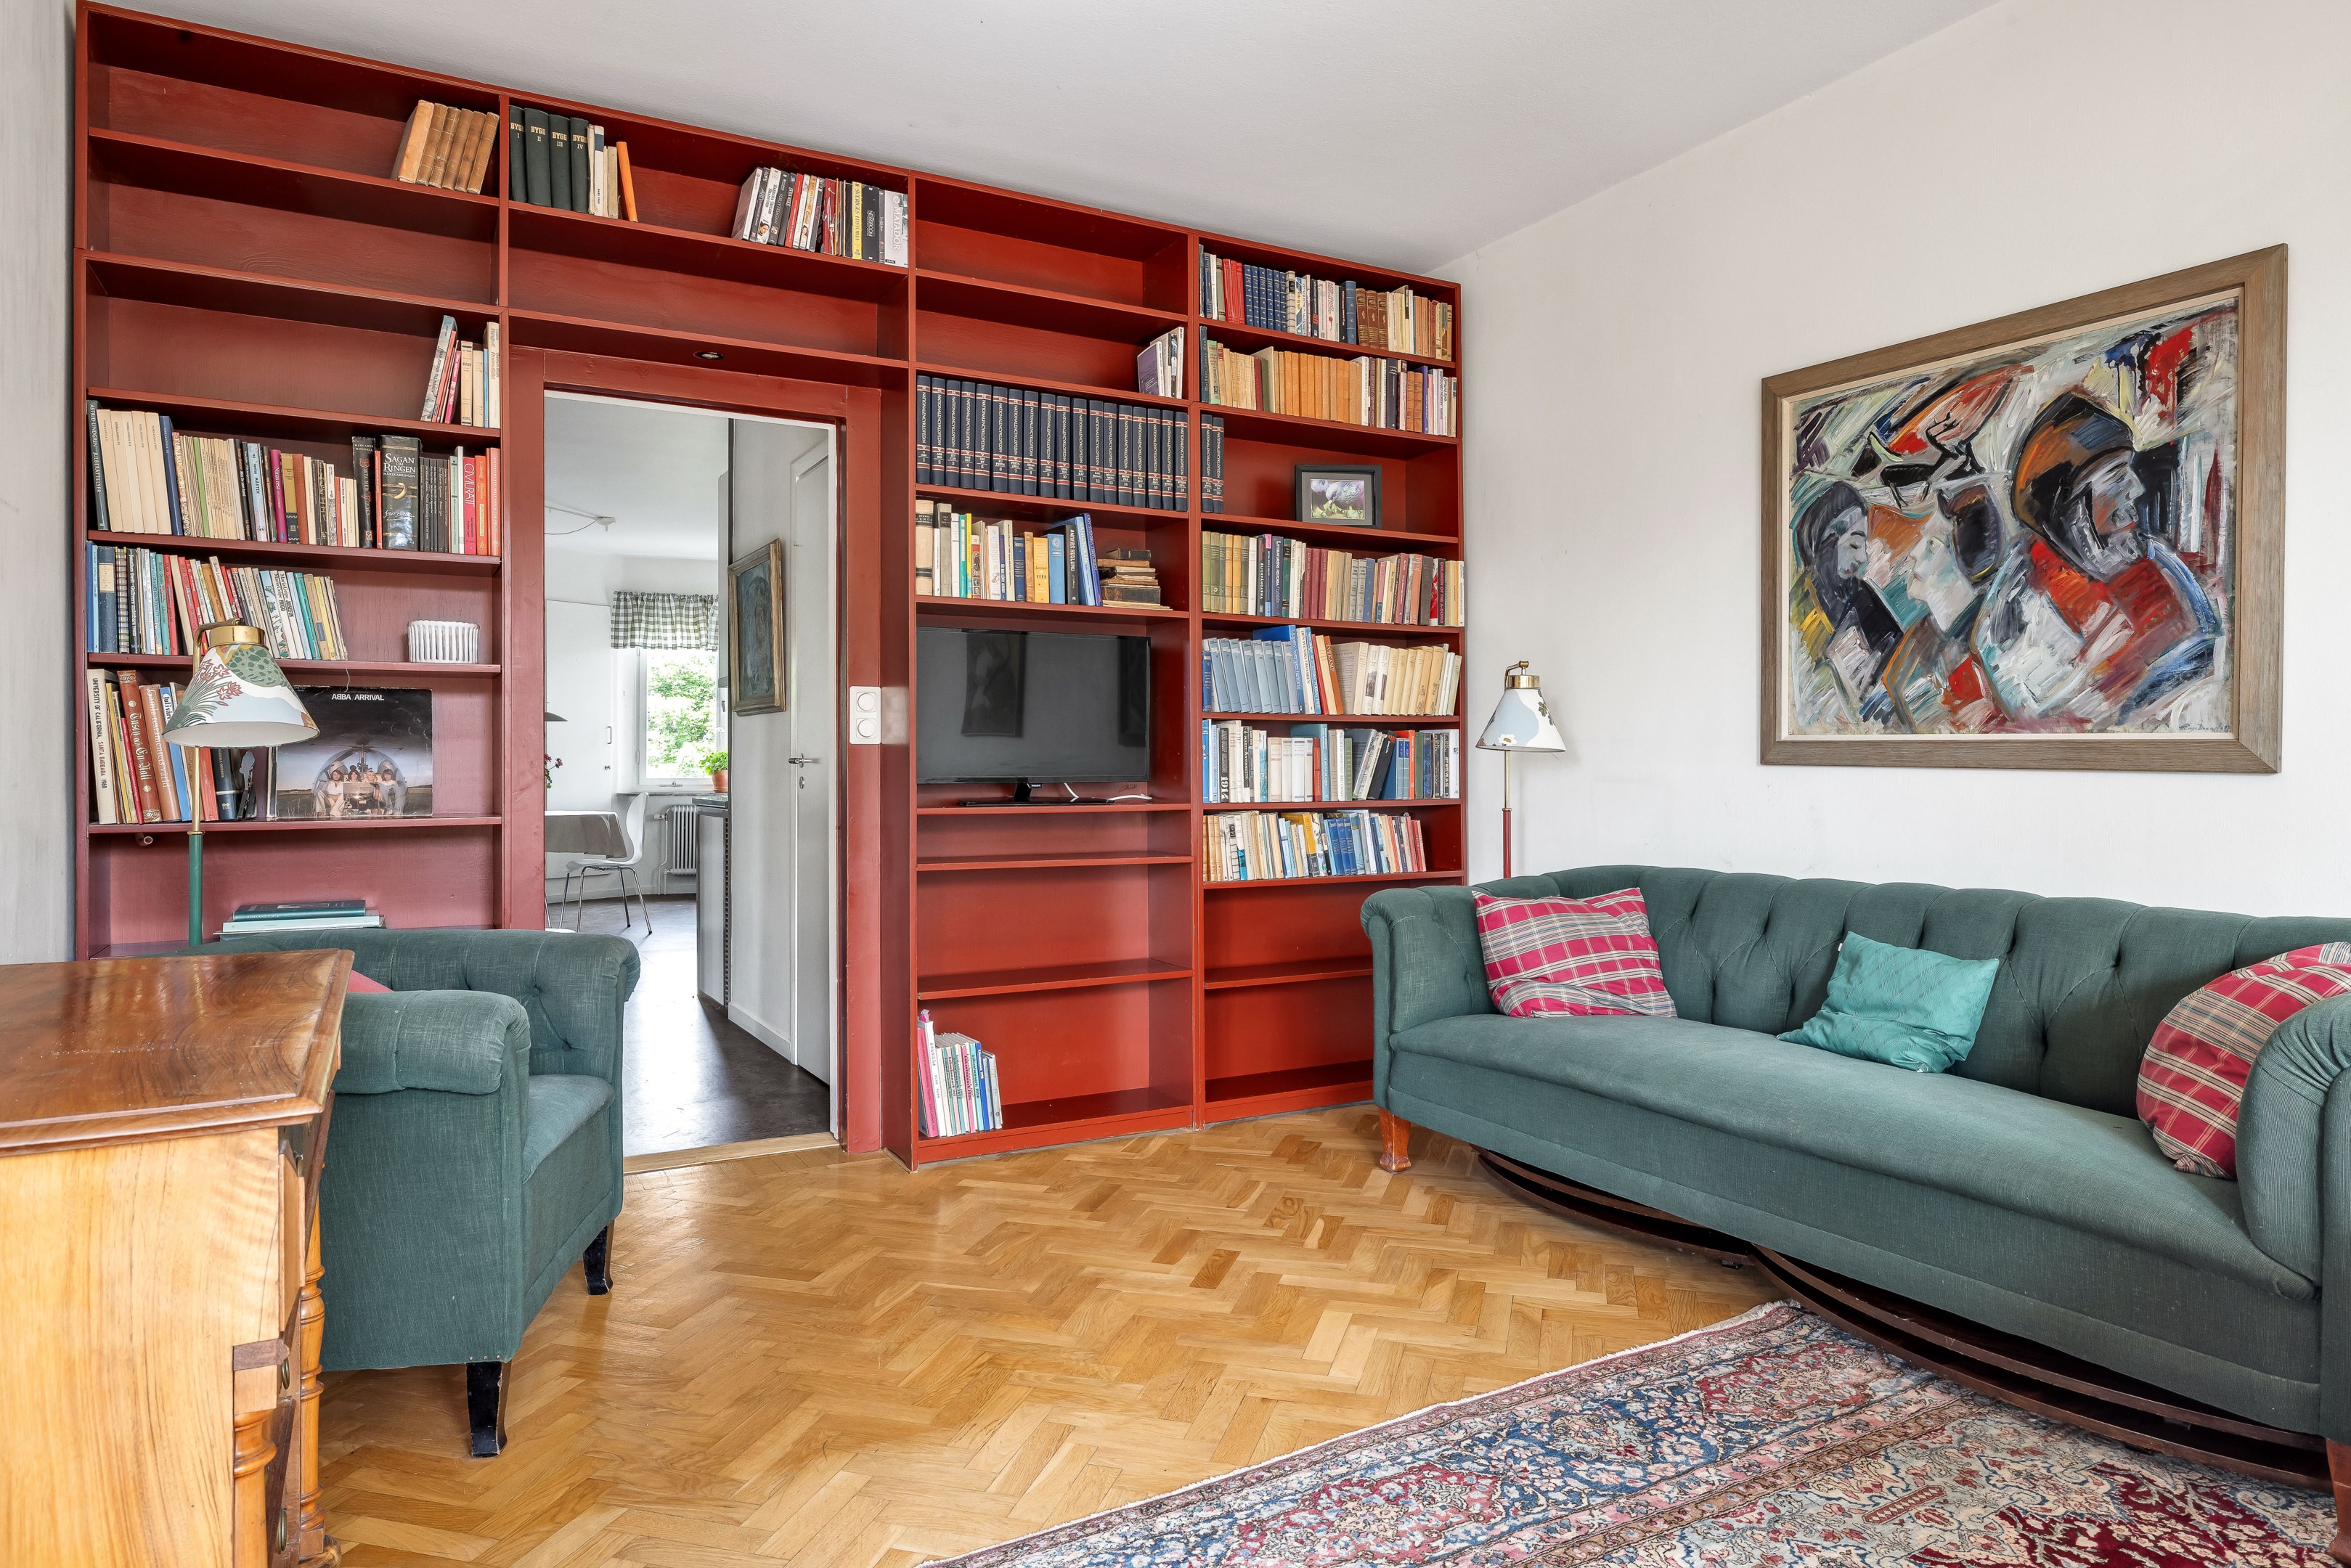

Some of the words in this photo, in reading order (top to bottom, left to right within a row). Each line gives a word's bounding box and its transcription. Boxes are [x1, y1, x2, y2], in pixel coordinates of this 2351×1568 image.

[531, 126, 545, 135] BYGG
[553, 132, 567, 141] BYGG
[385, 453, 415, 464] SAGAN
[383, 463, 415, 473] RINGEN
[1326, 643, 1335, 671] TVEKAMP
[92, 678, 101, 703] UNIVERSITY
[129, 713, 142, 735] Tusen
[135, 747, 148, 760] En
[151, 716, 165, 766] testamentets
[160, 768, 171, 788] värld
